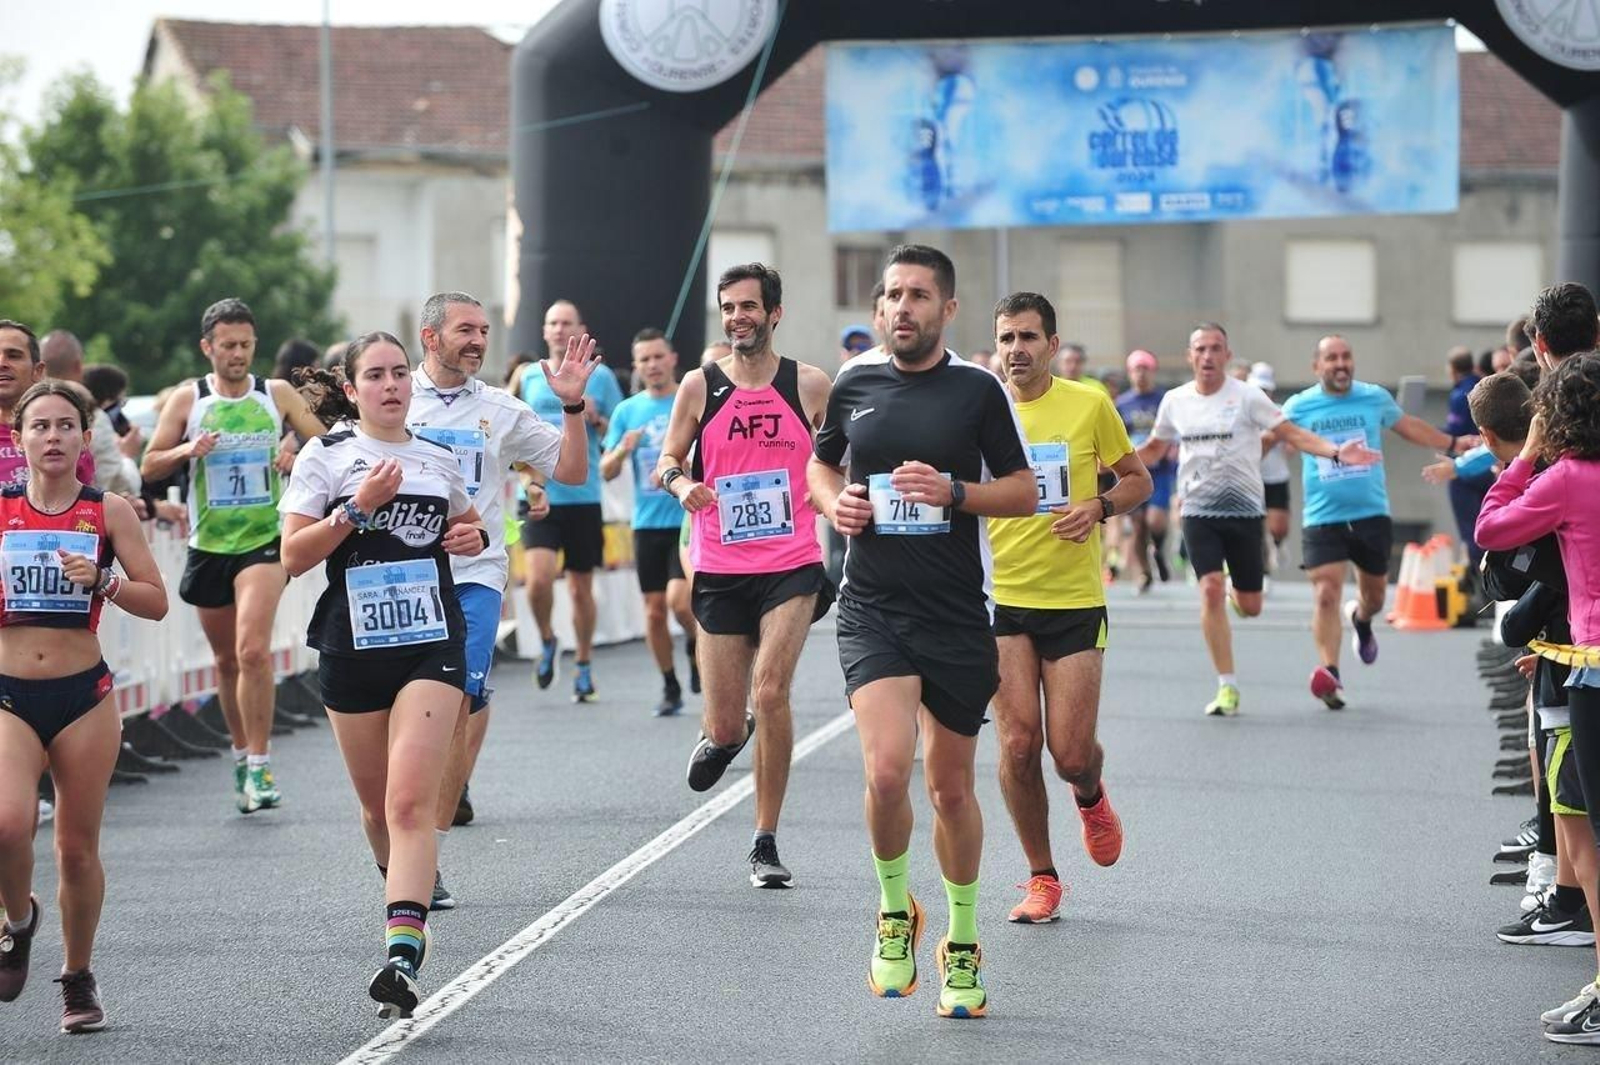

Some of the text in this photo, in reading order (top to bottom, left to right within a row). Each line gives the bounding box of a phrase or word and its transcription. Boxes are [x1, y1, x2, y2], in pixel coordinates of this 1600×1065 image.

[728, 414, 782, 441] AFJ
[758, 438, 796, 450] running
[229, 475, 246, 496] 71
[1035, 475, 1047, 500] 5
[732, 501, 772, 529] 283
[890, 499, 921, 521] 714
[357, 590, 379, 601] SARA
[362, 597, 428, 631] 3004
